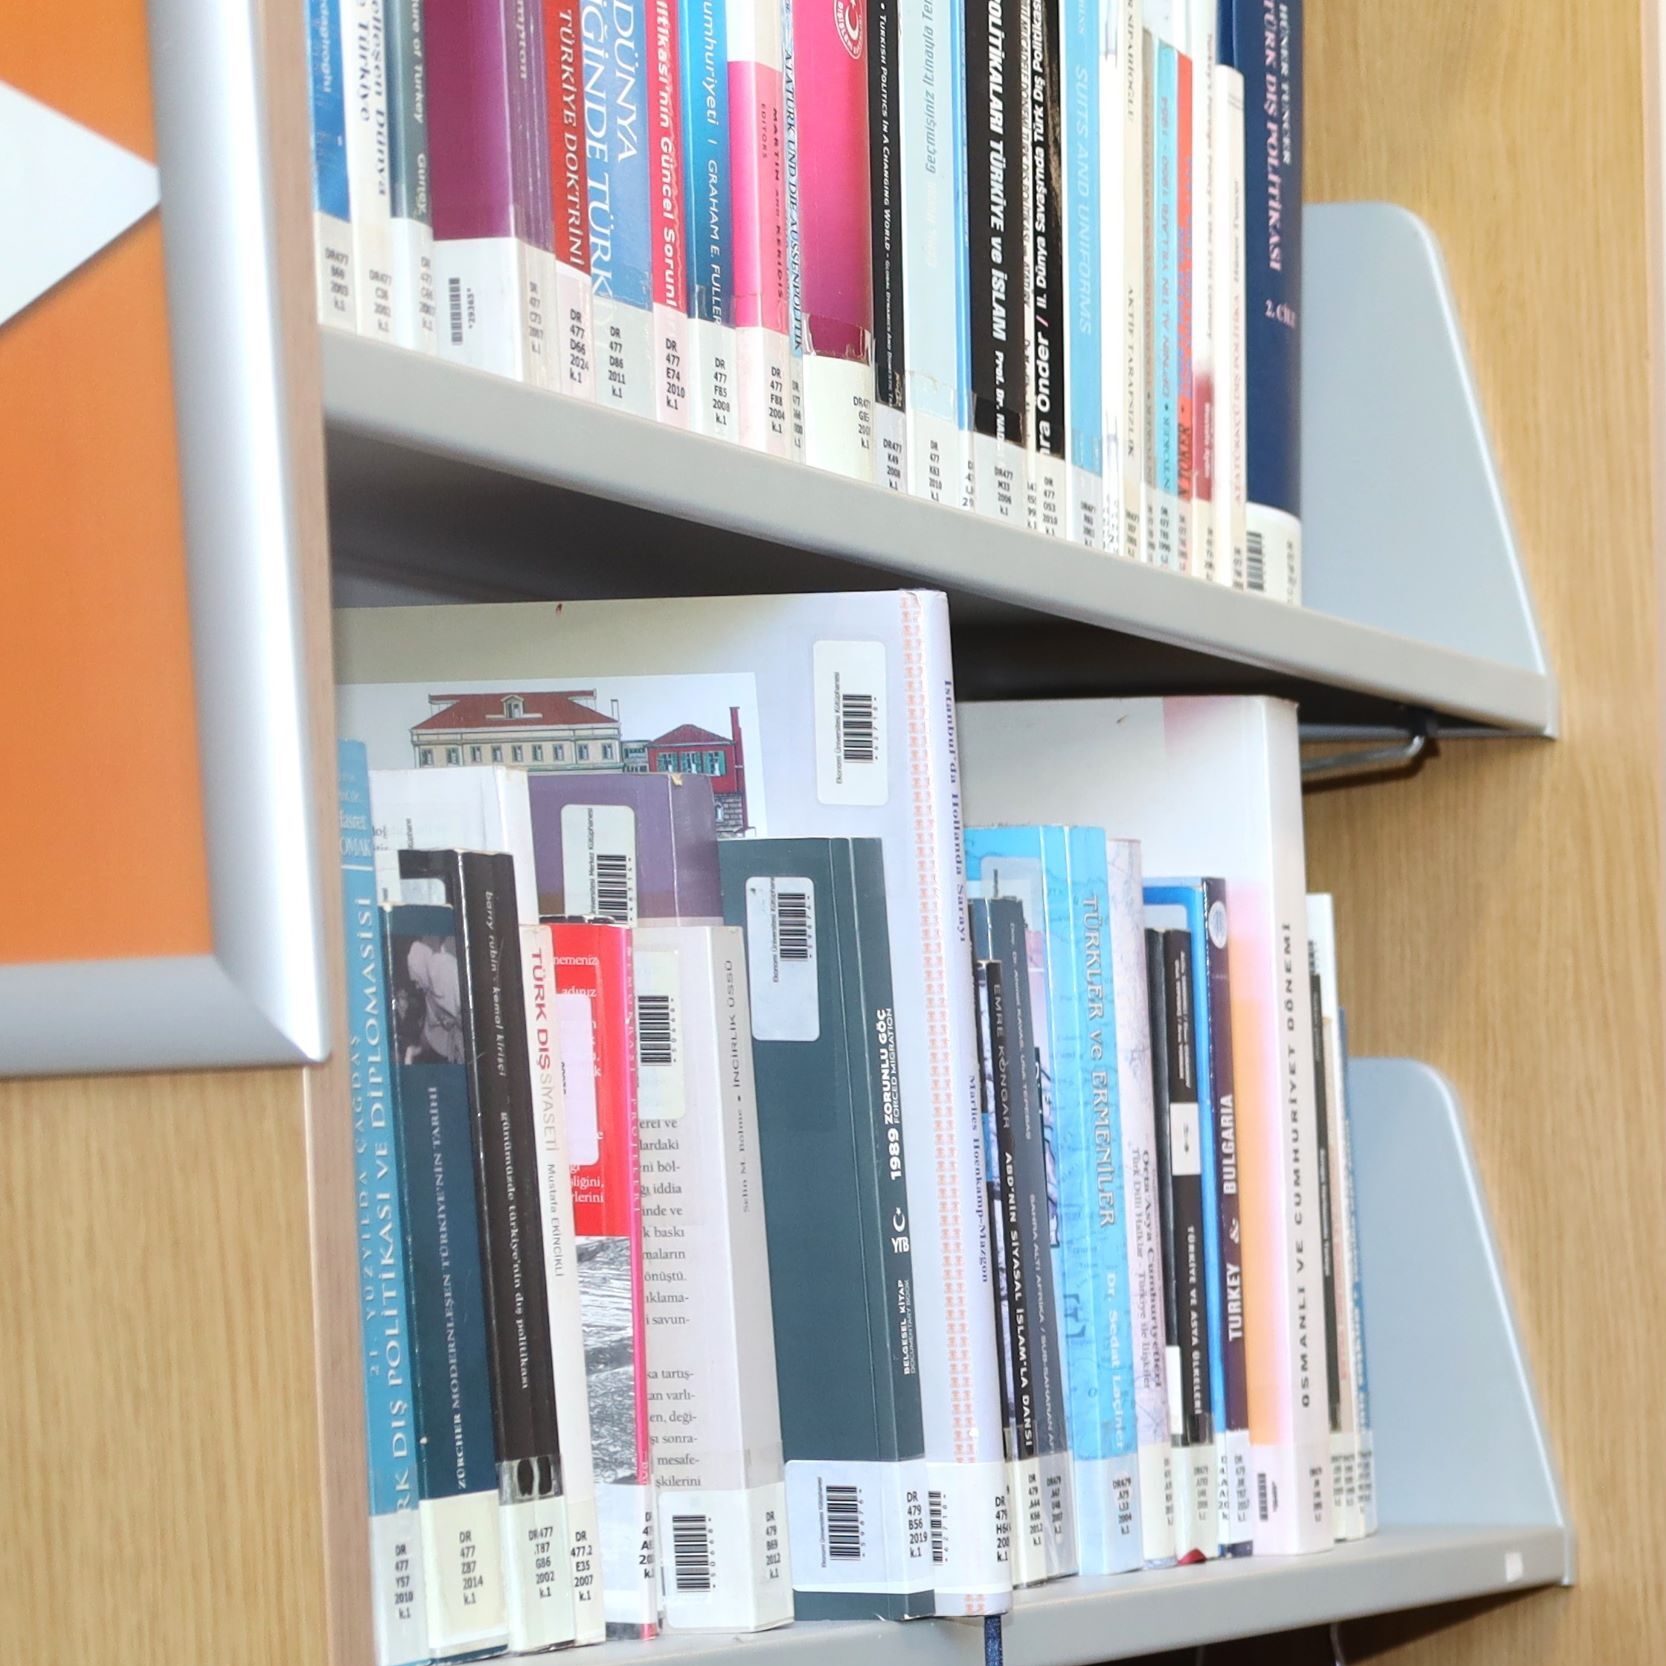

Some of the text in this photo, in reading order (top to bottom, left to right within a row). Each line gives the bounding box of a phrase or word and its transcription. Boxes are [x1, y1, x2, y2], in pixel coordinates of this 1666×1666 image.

[613, 2, 638, 163] DÜNYA
[881, 65, 889, 118] POLITICS
[559, 9, 584, 266] TÜRKİYE DOKTRİNİ
[990, 140, 1008, 231] TÜRKİYE
[1033, 78, 1047, 289] Dünya Dış
[708, 160, 720, 240] GRAHAM
[1076, 139, 1092, 336] AND UNIFORMS
[991, 234, 1003, 263] ve
[991, 268, 1008, 341] İSLAM
[570, 308, 582, 323] DR
[569, 325, 586, 341] 477
[610, 326, 621, 339] DR
[570, 339, 587, 355] D66
[608, 340, 623, 354] 477
[666, 339, 677, 353] DR
[665, 354, 680, 368] 477
[714, 357, 726, 370] DR
[666, 368, 681, 381] E74
[713, 373, 728, 386] 477
[771, 367, 782, 378] DR
[666, 383, 686, 398] 2010
[770, 379, 783, 392] 477
[1281, 923, 1295, 1032] DÖNEMİ
[531, 952, 548, 1020] TÜRK
[536, 1028, 552, 1071] DIŞ
[884, 1007, 901, 1124] FORCED MIGRATION
[1082, 895, 1117, 1228] TÜRKLER ve ERMENİLER
[876, 1007, 902, 1180] 1989 ZORUNLU GÖÇ
[427, 1086, 441, 1149] TARİHİ
[539, 1071, 560, 1152] SİYASETİ
[355, 898, 409, 1458] DIŞ POLİTİKASI VE DİPLOMASİSİ
[547, 1163, 560, 1214] Mustafa
[652, 1183, 682, 1195] iddia
[432, 1153, 451, 1272] TÜRKİYE'NİN
[669, 1207, 683, 1217] ve
[1220, 1093, 1243, 1343] TURKEY & BULGARIA
[653, 1226, 685, 1238] baskı
[500, 1111, 529, 1389] günümüzde türkiye'nin politikası
[897, 1279, 910, 1375] BELGESEL KİTAP
[438, 1273, 462, 1410] MODERNLEŞEN
[1010, 1230, 1033, 1448] SİYASAL İSLAM'LA DANSI
[1299, 1286, 1310, 1409] OSMANLI
[661, 1434, 698, 1445] sonra-
[656, 1454, 700, 1466] mesafe-
[906, 1491, 919, 1502] DR
[907, 1505, 922, 1517] 479
[908, 1519, 923, 1530] B56
[459, 1531, 472, 1543] DR
[575, 1530, 587, 1542] DR
[910, 1532, 928, 1544] 2019
[460, 1546, 476, 1559] 477
[575, 1560, 591, 1572] E35
[462, 1577, 484, 1590] 2014
[574, 1575, 594, 1587] 2007
